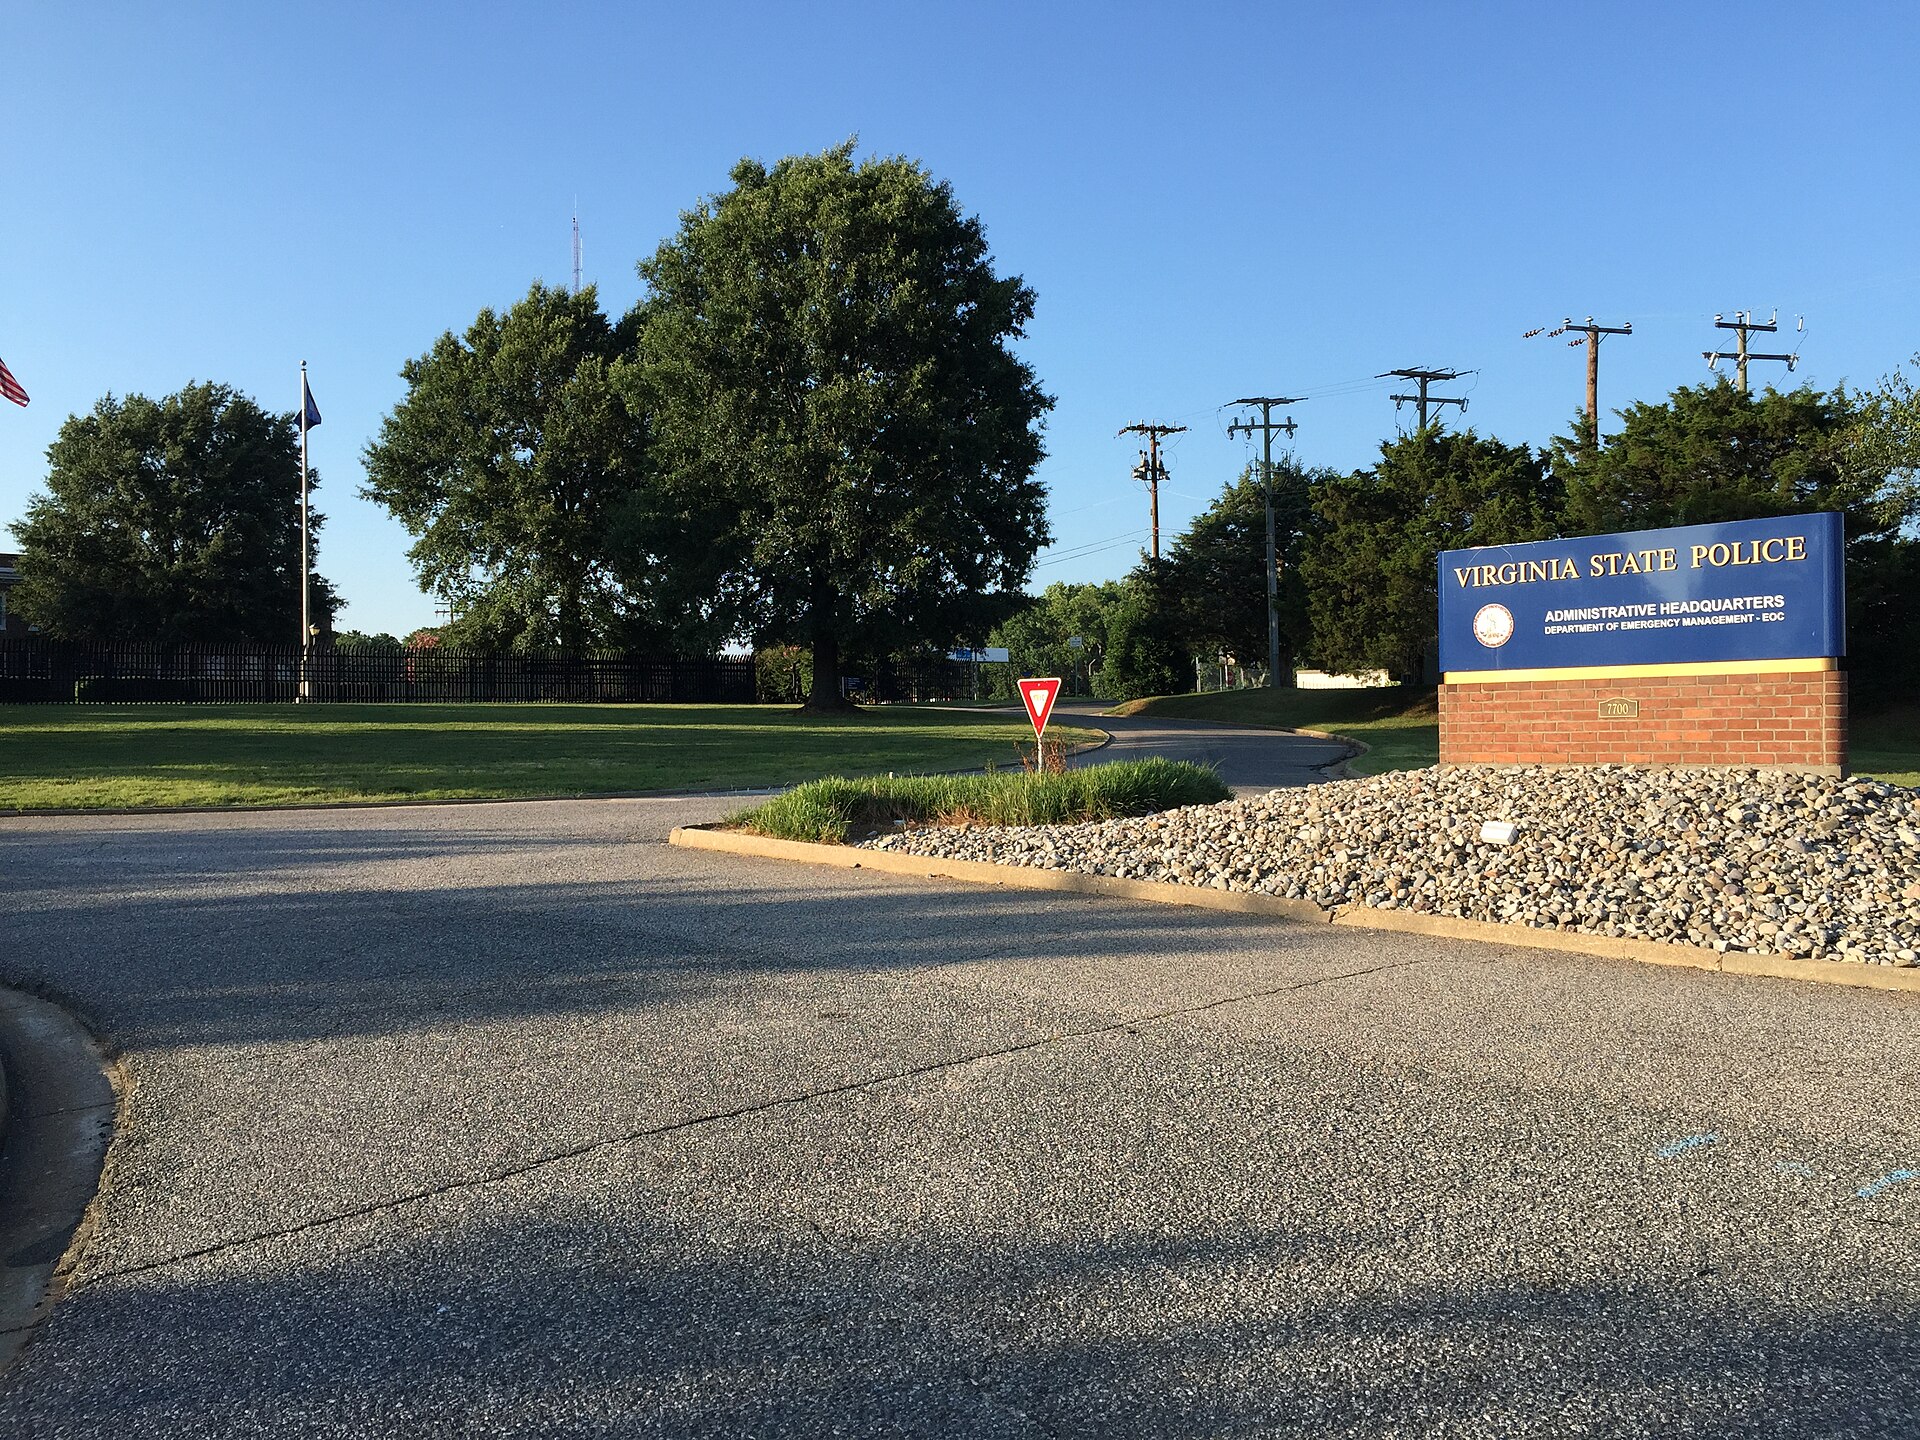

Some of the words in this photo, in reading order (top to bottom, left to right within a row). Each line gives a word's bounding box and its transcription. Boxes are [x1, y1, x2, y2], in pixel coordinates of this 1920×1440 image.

[1454, 557, 1580, 588] VIRGINIA
[1590, 548, 1678, 577] STATE
[1690, 536, 1807, 569] POLICE
[1545, 604, 1657, 622] ADMINISTRATIVE
[1660, 595, 1785, 615] HEADQUARTERS
[1544, 623, 1605, 635] DEPARTMENT
[1606, 622, 1620, 631] OF
[1620, 618, 1680, 630] EMERGENCY
[1682, 614, 1754, 627] MANAGEMENT
[1762, 612, 1785, 622] EOC
[1607, 703, 1628, 715] 7700
